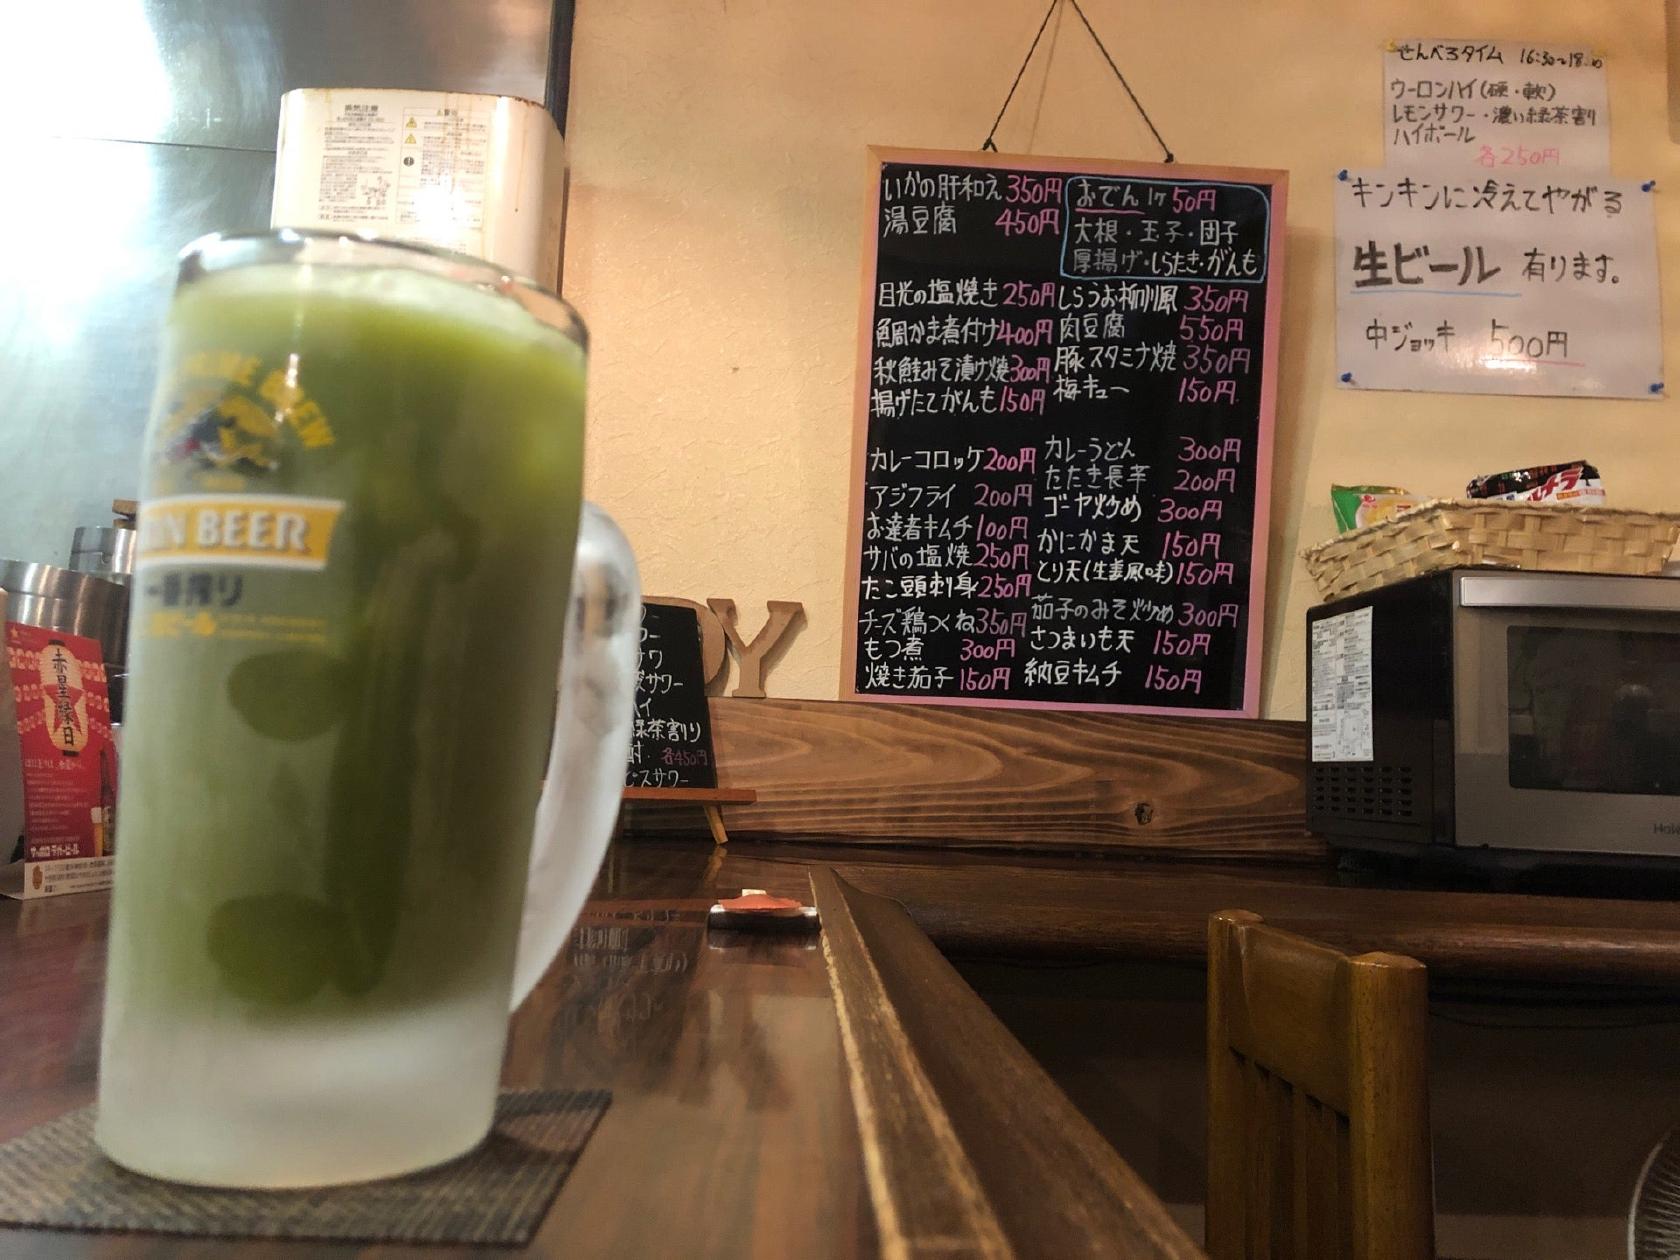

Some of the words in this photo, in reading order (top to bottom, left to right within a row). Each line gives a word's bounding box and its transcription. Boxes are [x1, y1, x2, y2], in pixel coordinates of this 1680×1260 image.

[1394, 122, 1476, 146] ハイボール
[1006, 175, 1062, 203] 350円
[1077, 179, 1139, 207] おでん
[1172, 186, 1216, 213] 50円
[1351, 177, 1624, 215] キンキンに冷えてやがる
[883, 201, 956, 237] 湯豆腐
[995, 208, 1060, 236] 450円
[1353, 240, 1502, 288] 生ビール
[1002, 280, 1055, 307] 250円
[1184, 285, 1248, 313] 350円
[996, 319, 1053, 346] 400円
[1060, 309, 1124, 344] 肉豆腐
[1180, 315, 1243, 342] 550円
[1366, 318, 1457, 352] 中ジョッキ
[1491, 318, 1569, 358] 500円
[1010, 354, 1050, 383] 300円
[1054, 340, 1177, 375] 豚スタミナ焼
[1183, 344, 1250, 374] 350円
[1000, 385, 1045, 415] 150円
[1053, 374, 1129, 403] 梅キュー
[1179, 377, 1236, 405] 150円
[870, 446, 984, 472] カレーコロッケ
[984, 448, 1036, 474] 200円
[1045, 434, 1135, 462] カレーうどん
[1178, 436, 1242, 464] 300円
[870, 482, 956, 509] アジフライ
[974, 483, 1033, 507] 200円
[1173, 468, 1236, 493] 200円
[1044, 491, 1142, 523] ゴーヤ炒め
[1157, 498, 1222, 523] 300円
[197, 510, 311, 553] BEER
[976, 514, 1028, 541] 100円
[863, 543, 975, 571] サバの塩焼
[974, 542, 1029, 570] 250円
[1037, 527, 1140, 556] かにかま天
[1162, 530, 1221, 560] 150円
[977, 573, 1032, 599] 250円
[1176, 561, 1234, 586] 150円
[976, 607, 1027, 638] 350円
[1178, 602, 1239, 628] 300円
[864, 634, 925, 661] もつ煮
[960, 638, 1016, 661] 300円
[1030, 625, 1135, 653] さつまいも天
[1153, 629, 1211, 656] 150円
[865, 661, 954, 690] 焼き茄子
[960, 667, 1011, 691] 150円
[1024, 657, 1122, 688] 納豆キムチ
[1145, 664, 1202, 695] 150円
